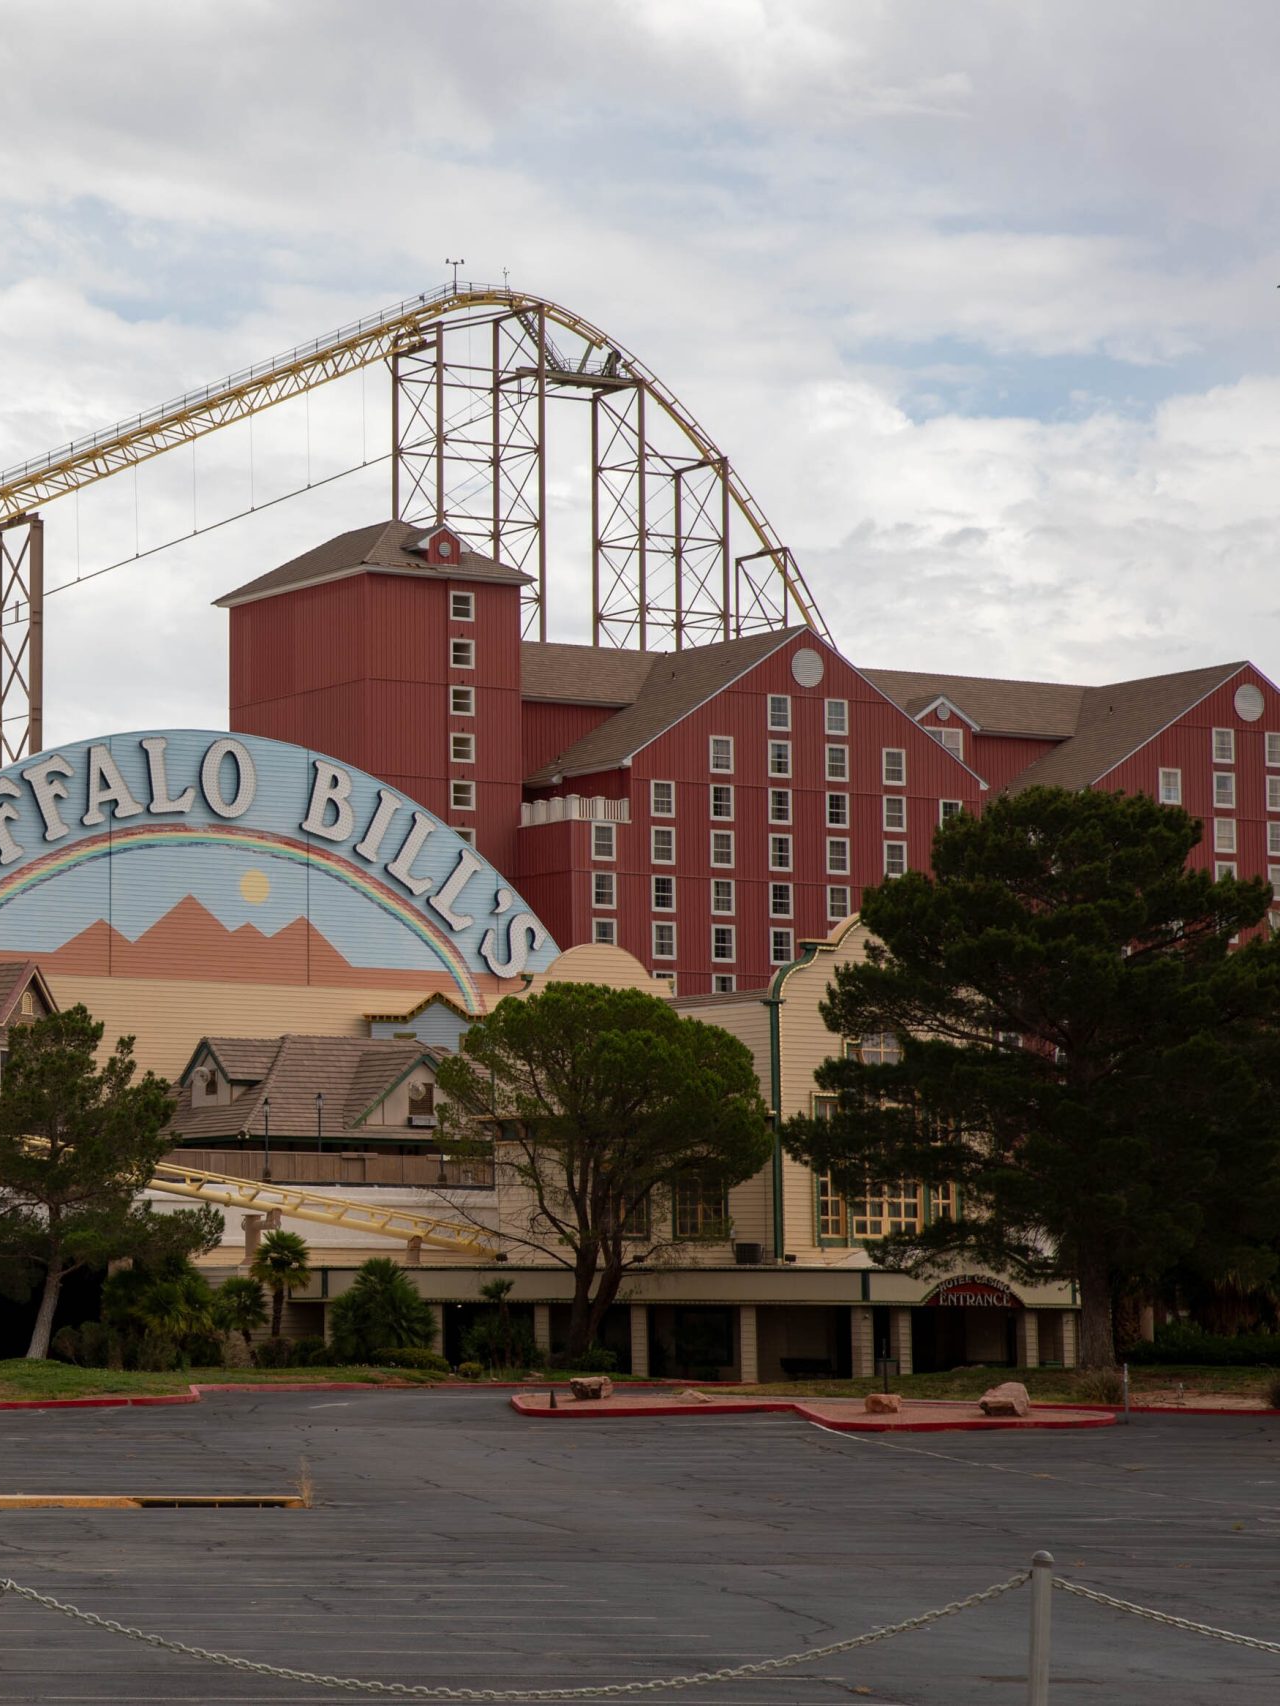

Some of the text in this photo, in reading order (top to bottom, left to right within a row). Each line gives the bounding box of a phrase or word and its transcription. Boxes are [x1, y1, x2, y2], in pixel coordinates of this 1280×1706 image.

[300, 760, 547, 980] BILL'S
[939, 1274, 1011, 1293] HOTEL CASINO
[939, 1292, 1011, 1306] ENTRANCE
